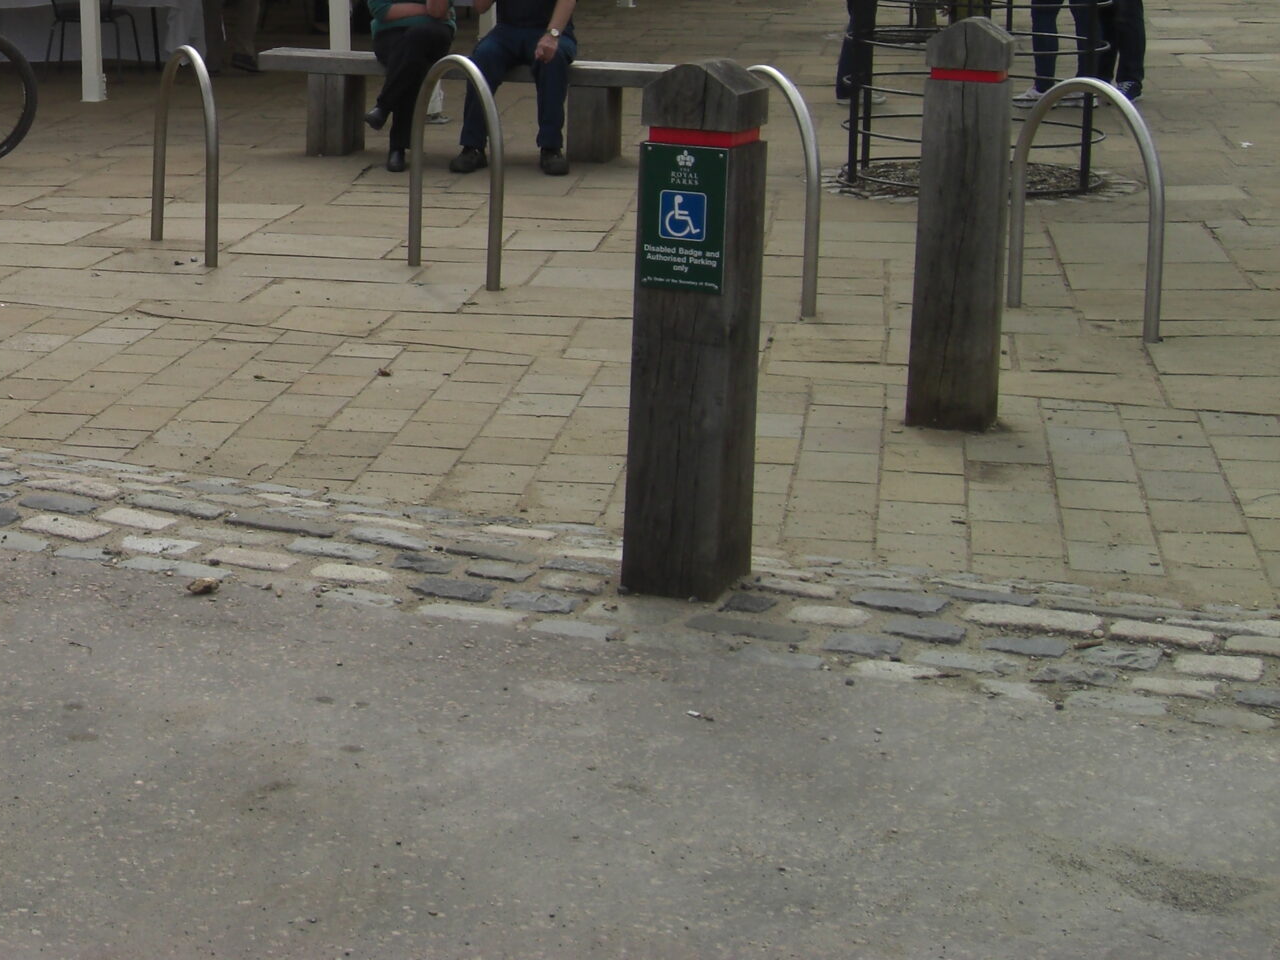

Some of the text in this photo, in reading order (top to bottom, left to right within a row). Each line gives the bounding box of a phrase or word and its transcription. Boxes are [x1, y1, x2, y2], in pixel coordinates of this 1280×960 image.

[671, 171, 699, 179] ROYAL
[670, 178, 699, 186] PARKS
[643, 244, 676, 254] Disabled
[678, 247, 703, 257] Badge
[646, 253, 717, 268] Authorised Parking
[673, 265, 689, 273] only
